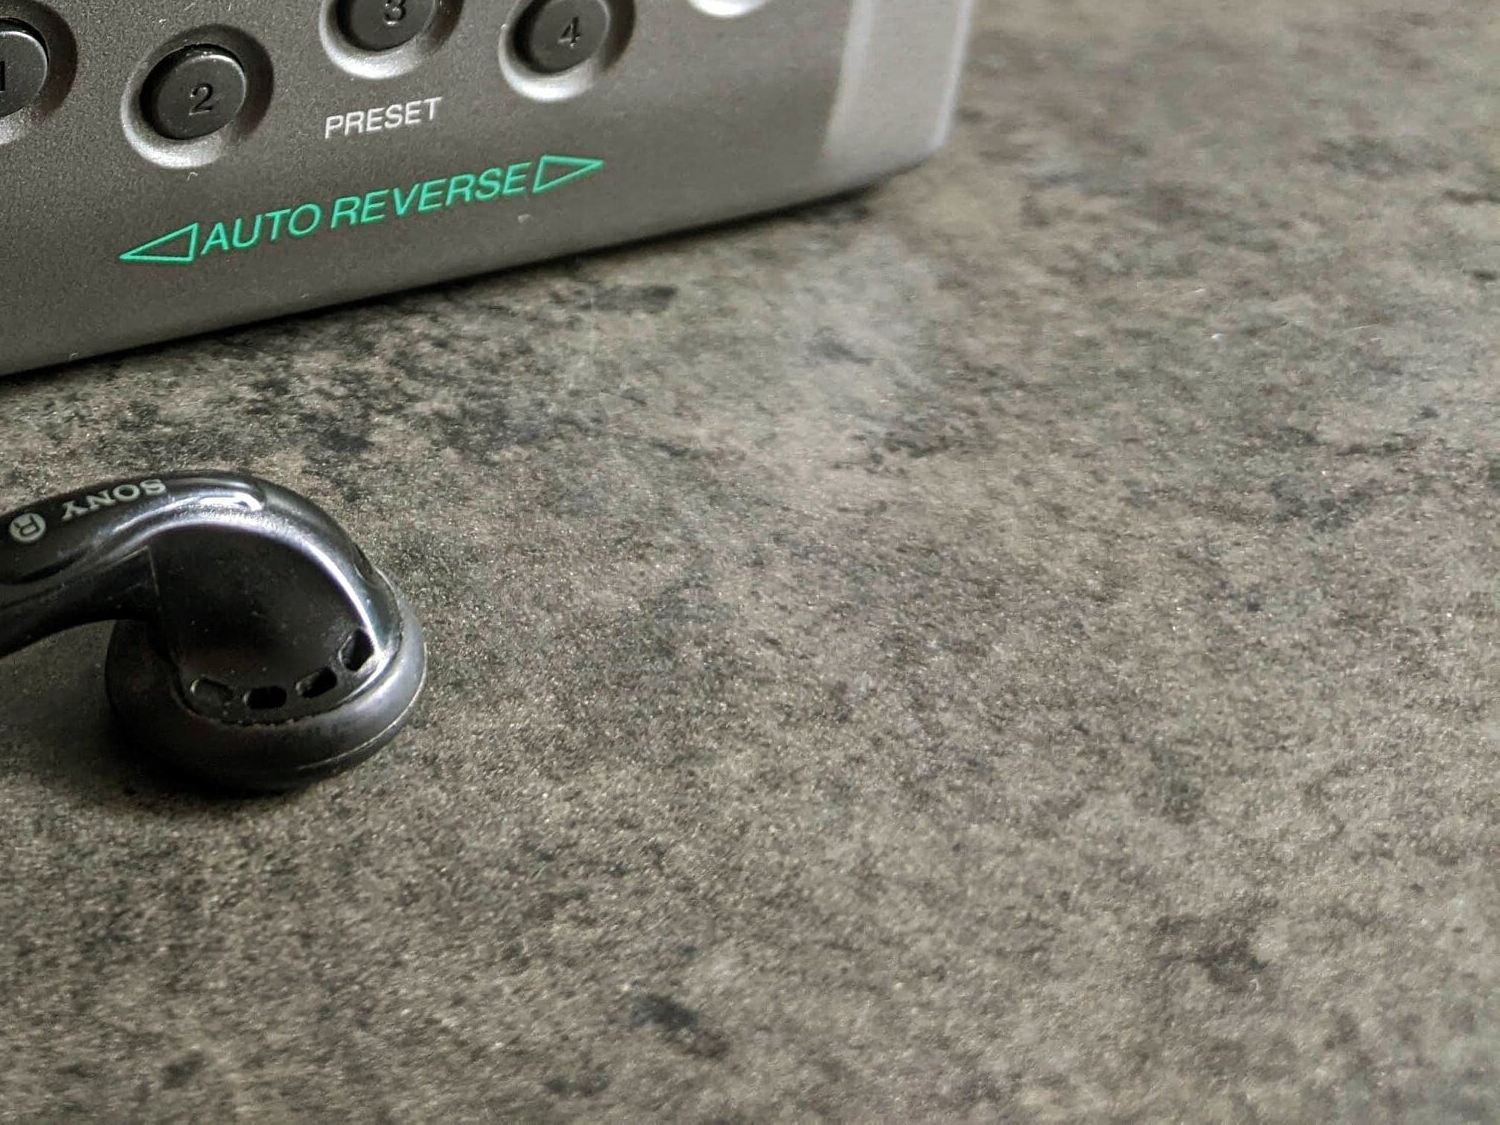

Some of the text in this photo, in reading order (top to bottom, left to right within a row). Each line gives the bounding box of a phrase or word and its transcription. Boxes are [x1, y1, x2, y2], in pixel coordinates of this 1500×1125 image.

[556, 15, 582, 48] 4
[188, 81, 215, 115] 2
[324, 97, 442, 139] PRESET
[201, 162, 532, 255] AUTO REVERSE
[61, 479, 167, 522] SONY
